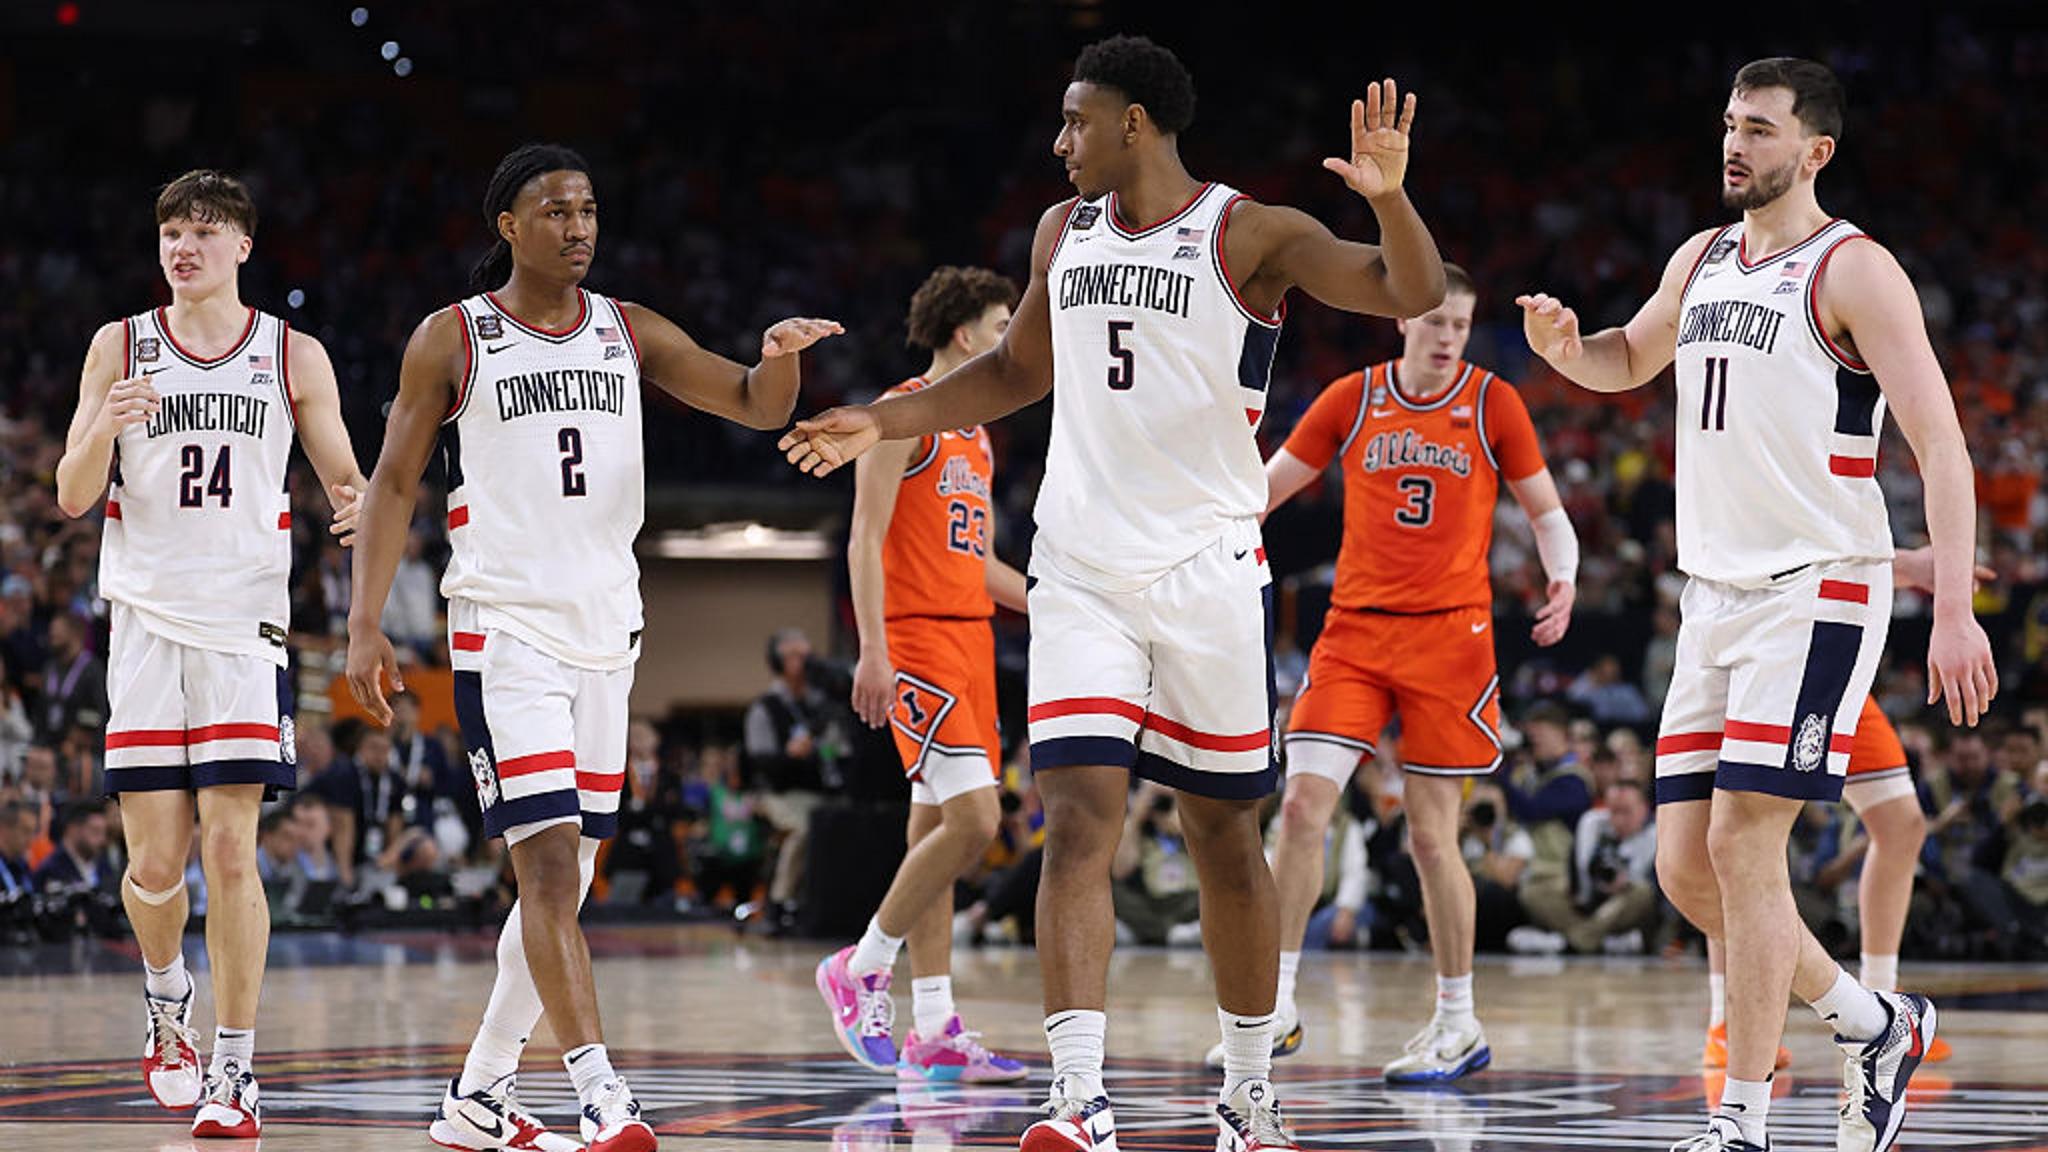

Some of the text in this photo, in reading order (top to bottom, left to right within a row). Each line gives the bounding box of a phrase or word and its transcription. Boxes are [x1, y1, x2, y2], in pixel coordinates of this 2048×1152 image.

[1060, 264, 1195, 318] CONNECTICUT
[1108, 320, 1134, 390] 5
[1678, 299, 1785, 355] CONNECTICUT
[495, 369, 625, 422] CONNECTICUT
[1701, 357, 1729, 430] 11
[179, 444, 232, 508] 24
[558, 427, 587, 497] 2
[1363, 427, 1471, 477] Illinois
[1394, 475, 1436, 528] 3
